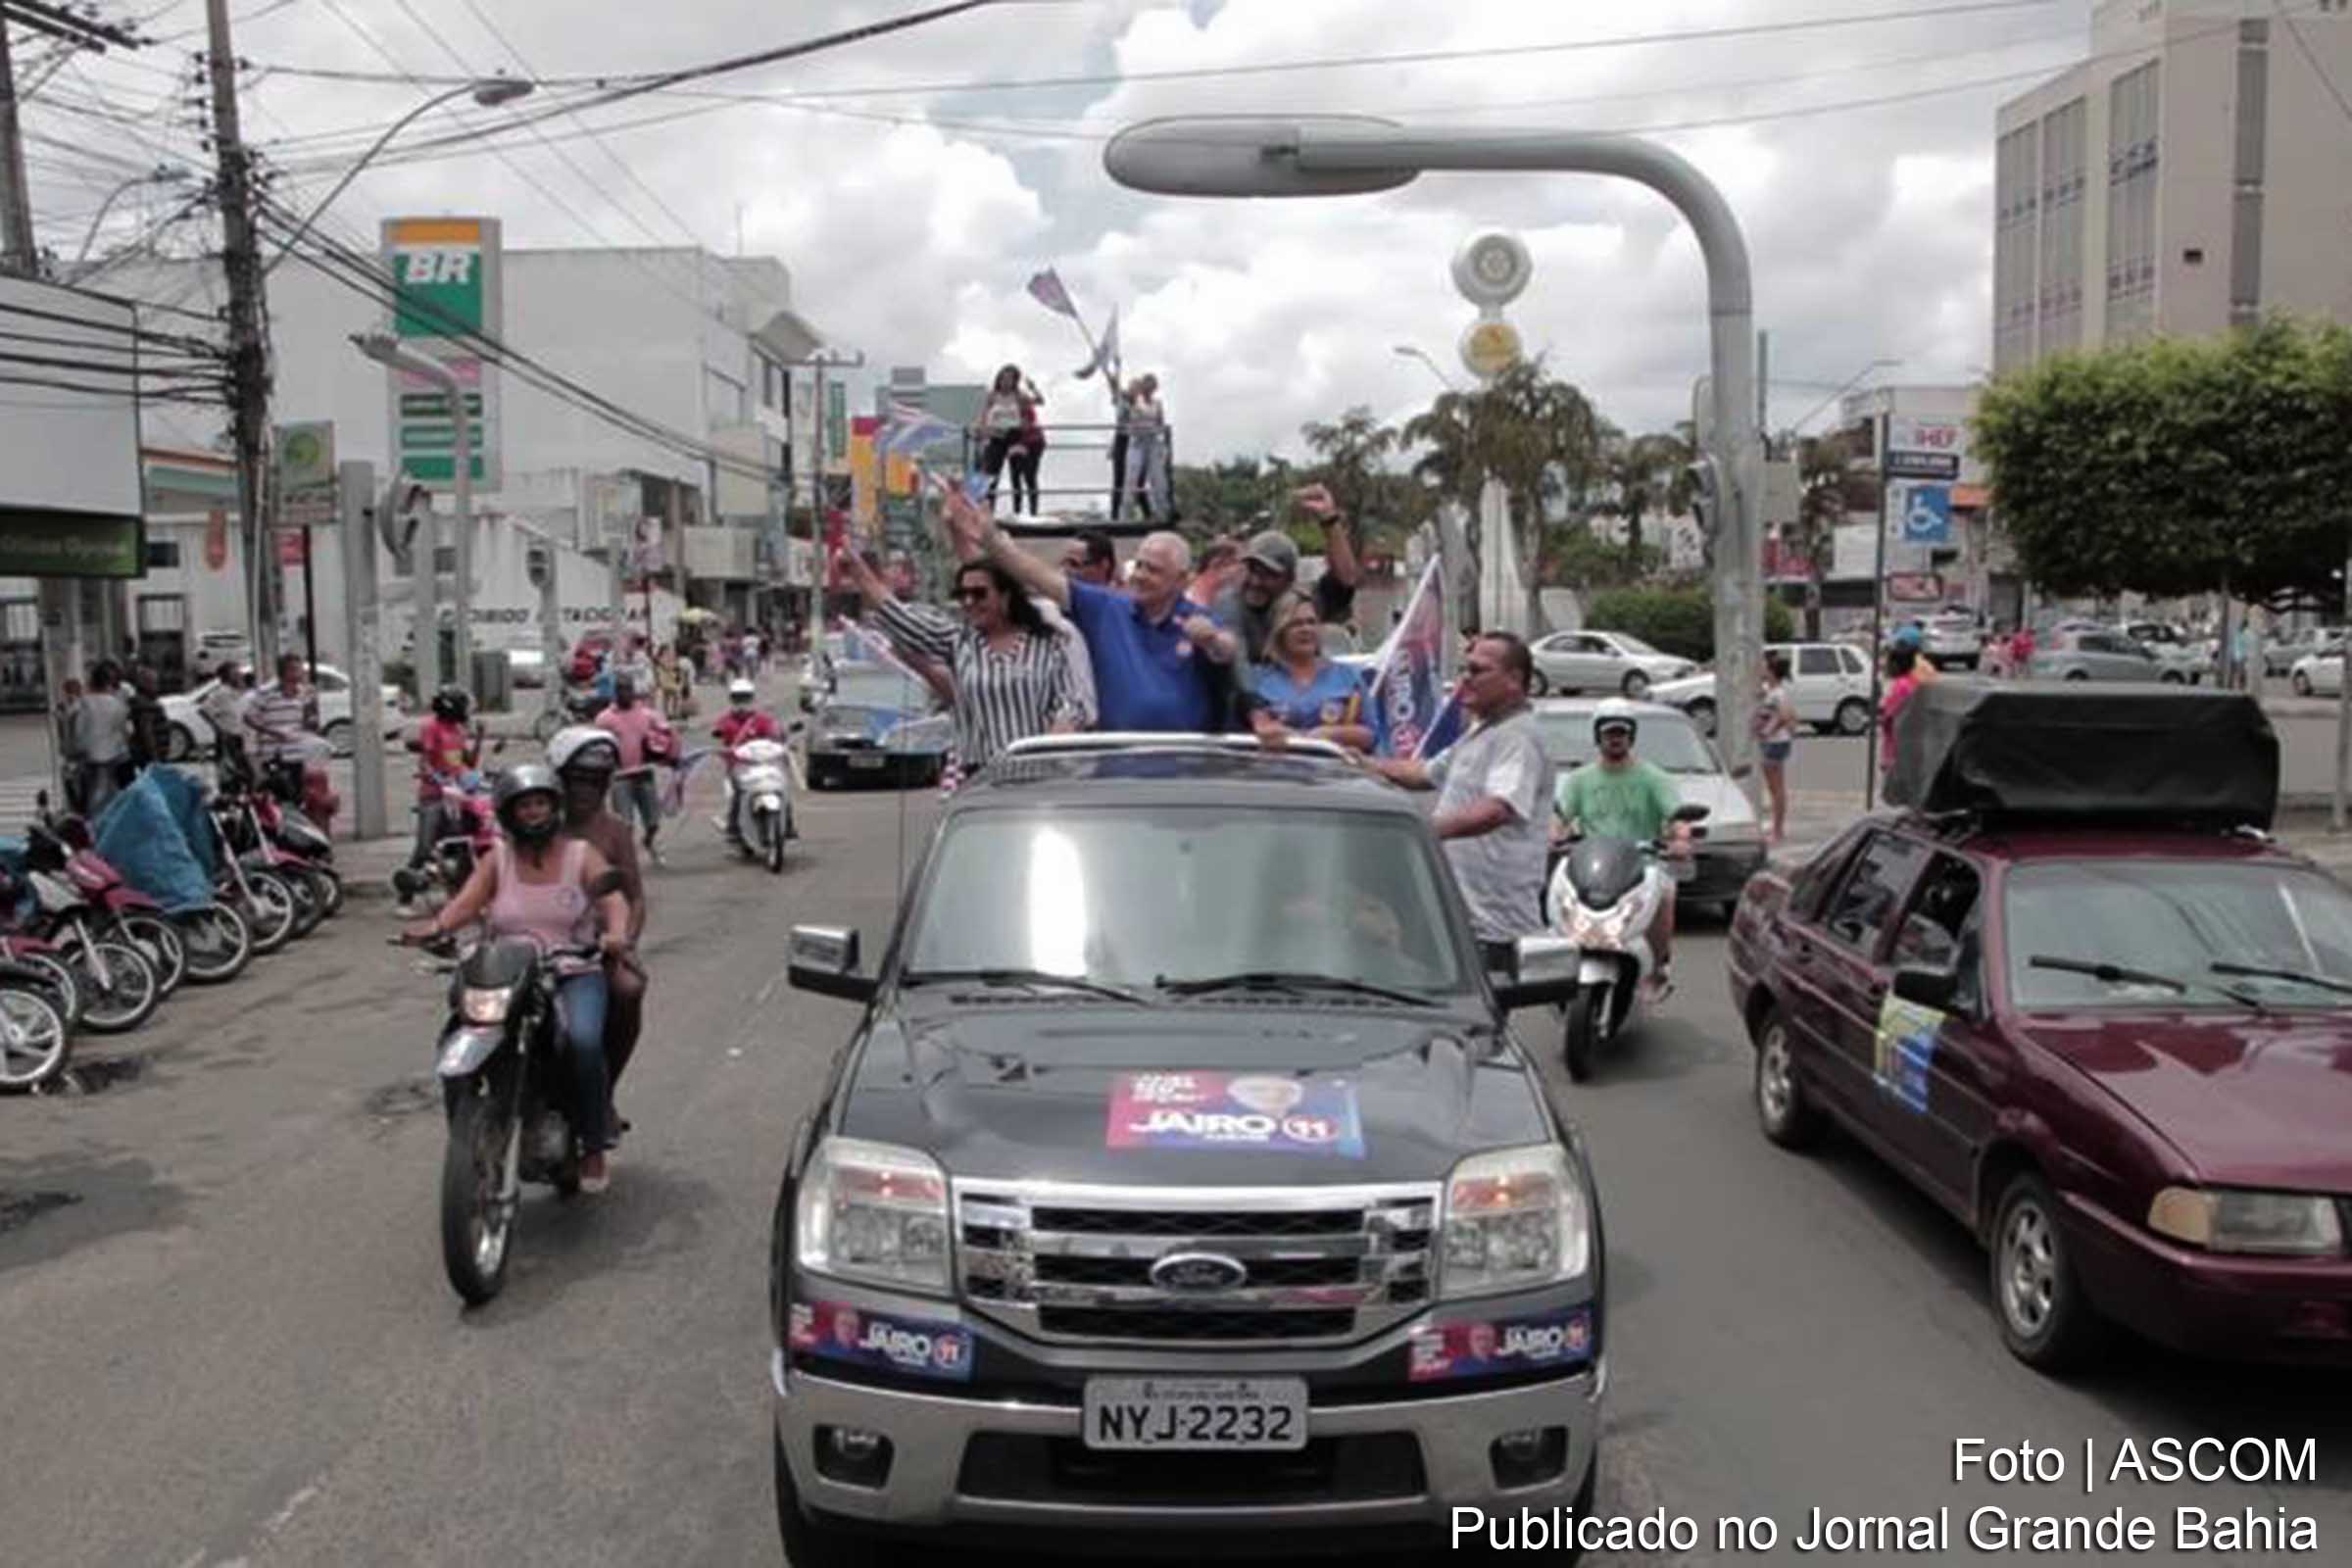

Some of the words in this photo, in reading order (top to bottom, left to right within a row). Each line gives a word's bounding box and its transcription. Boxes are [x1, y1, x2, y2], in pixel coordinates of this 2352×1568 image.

[405, 250, 472, 285] BR
[1129, 1111, 1278, 1135] JAIRO
[1294, 1119, 1330, 1138] 11
[858, 1322, 931, 1358] JAIRO
[1494, 1325, 1562, 1356] JAIRO
[1099, 1403, 1292, 1442] NYJ-2232
